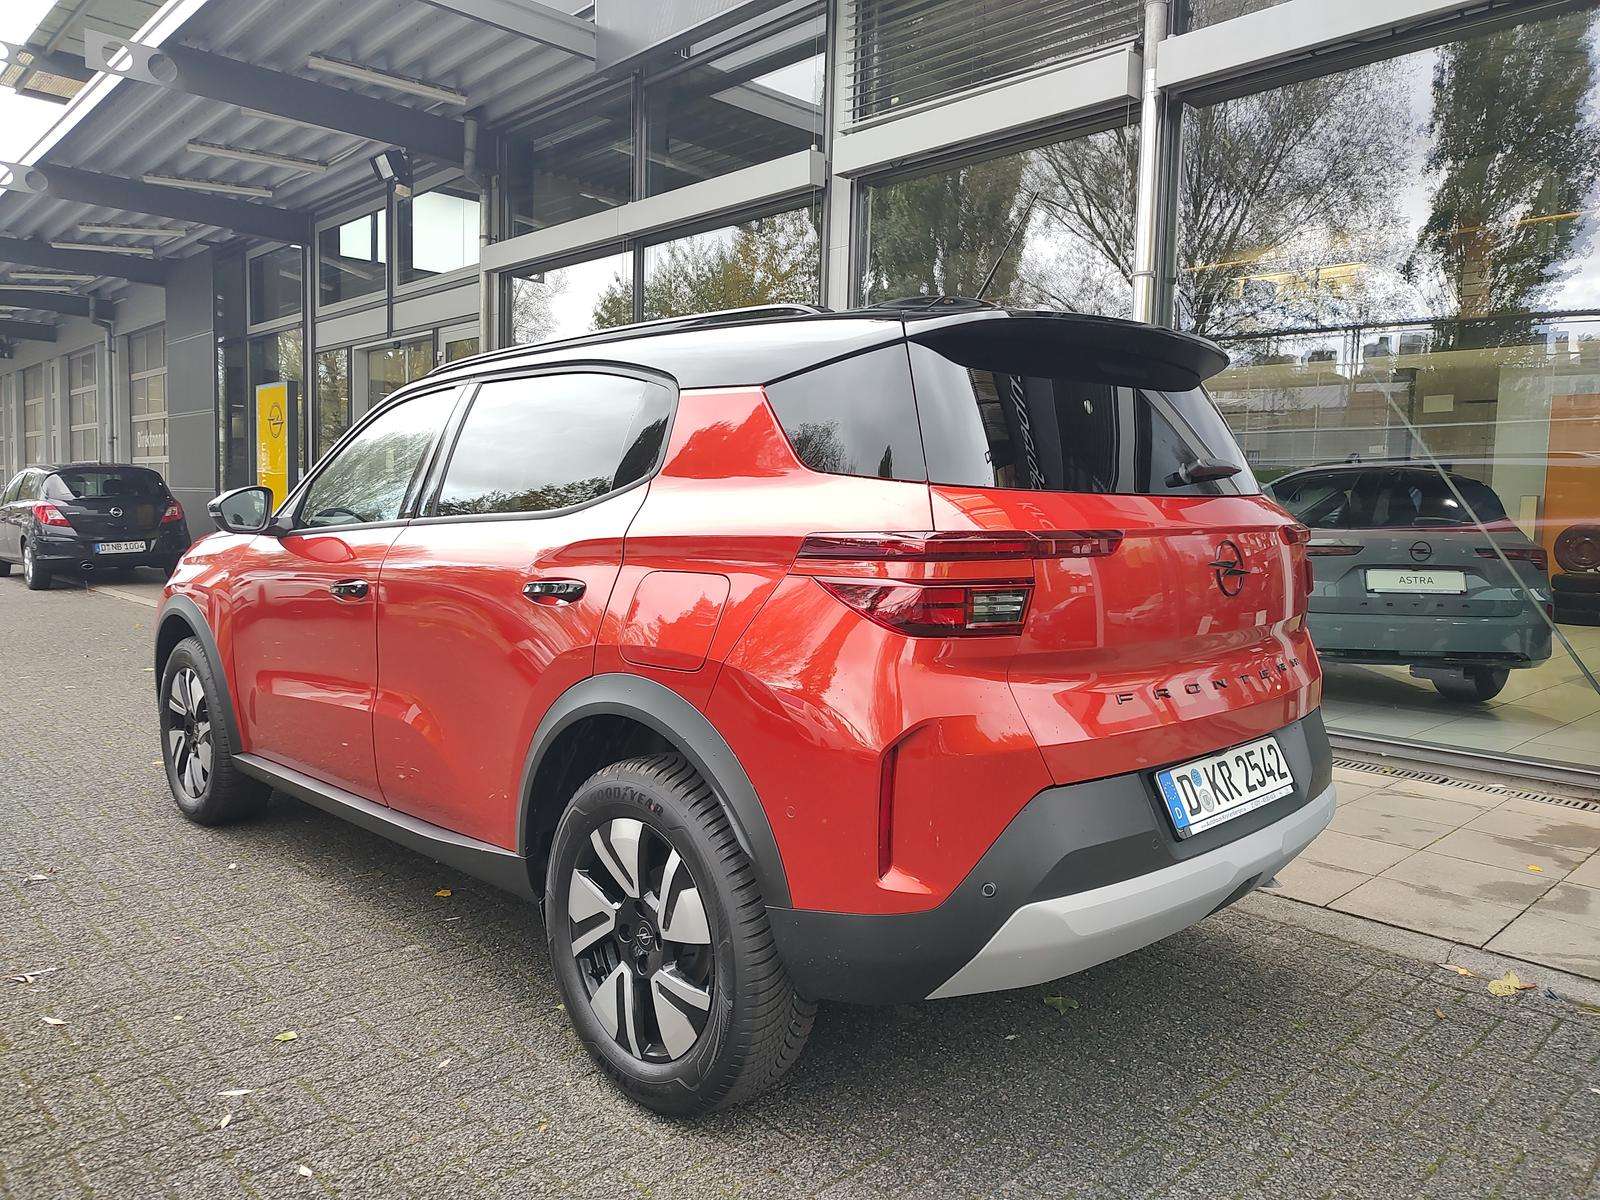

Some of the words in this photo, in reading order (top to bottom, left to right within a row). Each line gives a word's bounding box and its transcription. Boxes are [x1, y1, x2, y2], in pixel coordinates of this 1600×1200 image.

[1398, 576, 1435, 585] ASTRA
[1176, 774, 1202, 817] D
[1203, 760, 1243, 806] KR
[1234, 743, 1288, 792] 2542
